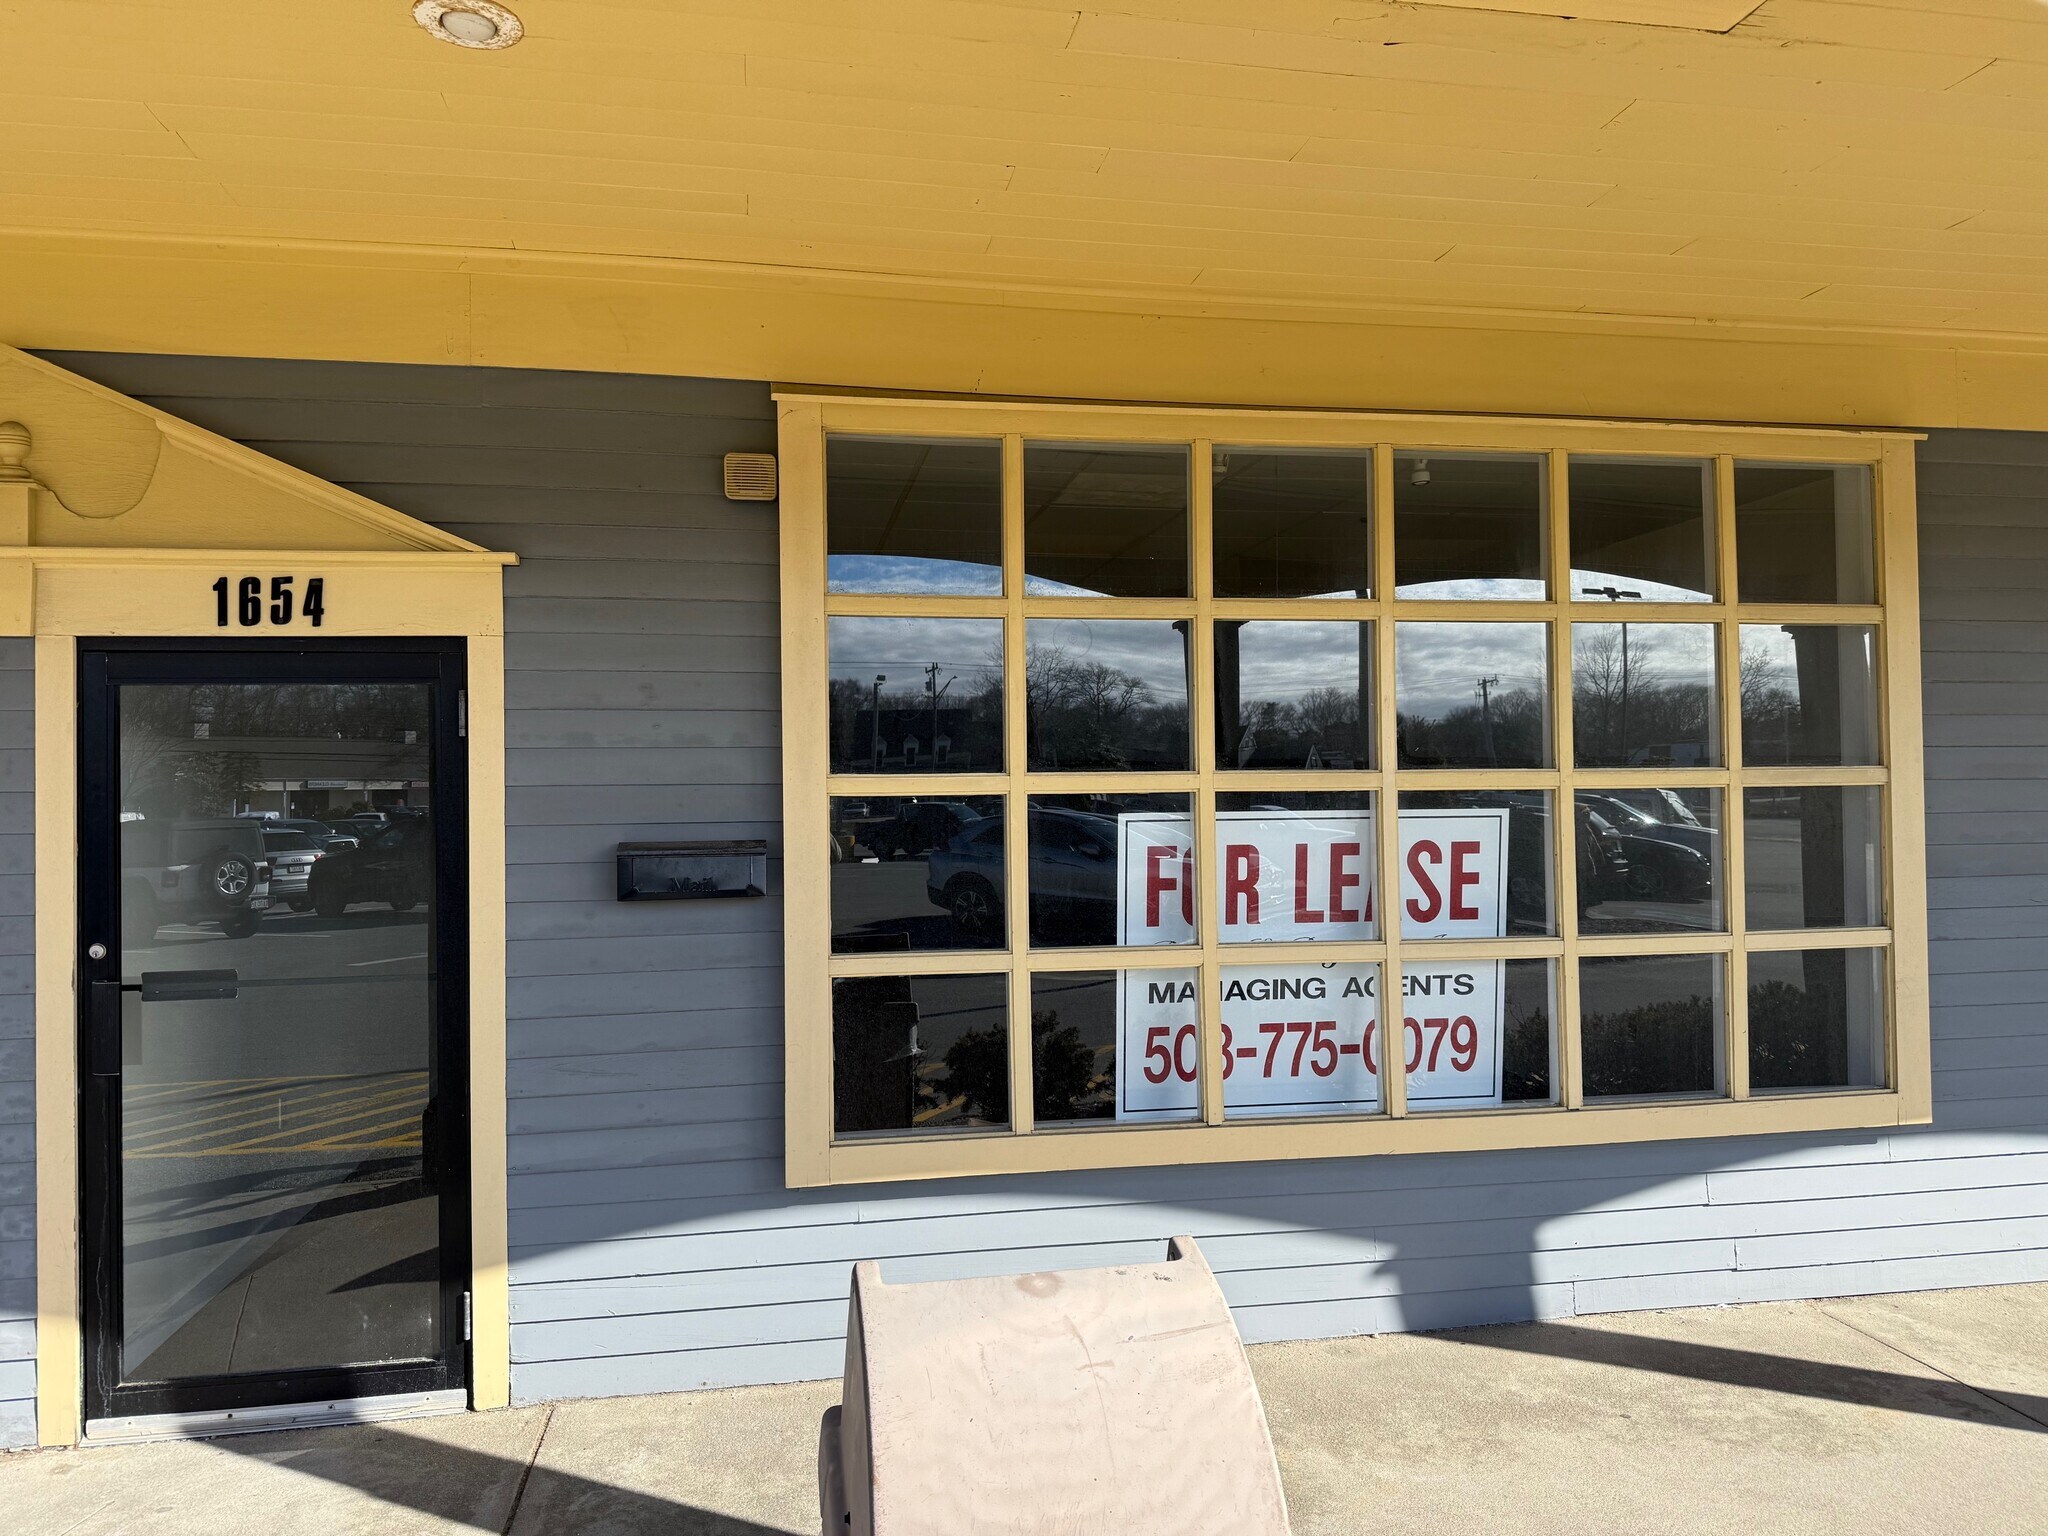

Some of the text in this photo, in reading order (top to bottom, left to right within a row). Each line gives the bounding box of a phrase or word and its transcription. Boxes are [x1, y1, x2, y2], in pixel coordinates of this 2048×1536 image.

[213, 576, 324, 627] 1654
[1294, 840, 1480, 923] LESE
[1148, 978, 1326, 1004] MAAGING
